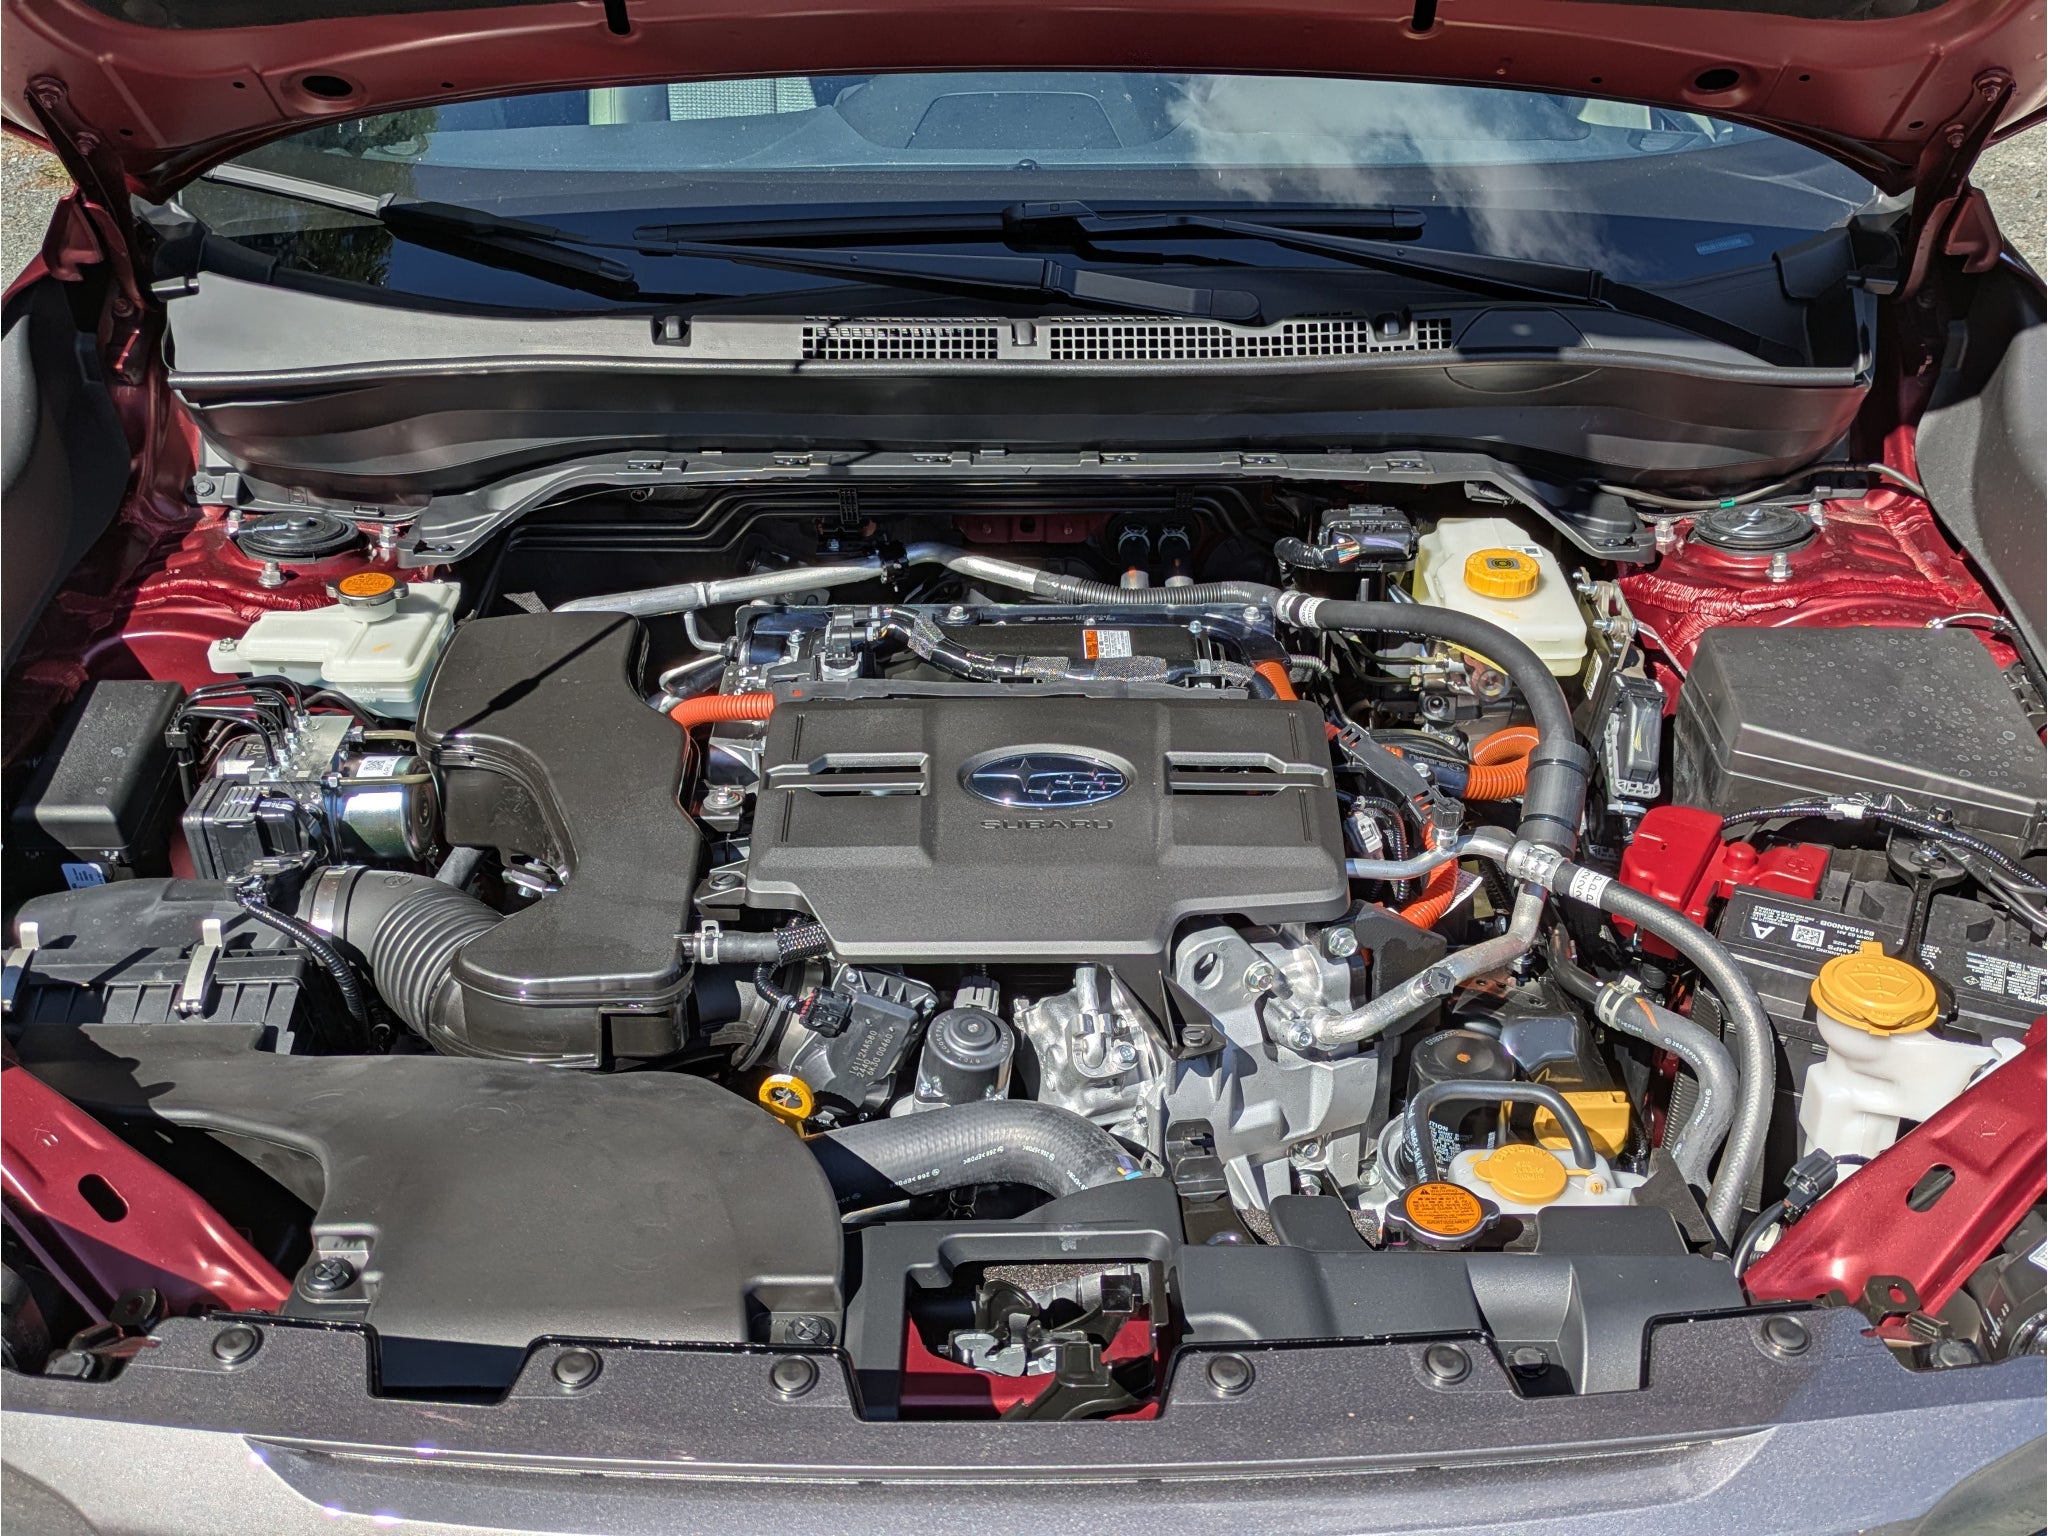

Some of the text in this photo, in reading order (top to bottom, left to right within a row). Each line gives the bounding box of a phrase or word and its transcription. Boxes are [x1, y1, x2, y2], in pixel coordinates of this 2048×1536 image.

[980, 819, 1114, 829] SUBARU
[1576, 880, 1598, 892] 2 P
[1751, 922, 1776, 940] A
[1827, 944, 1853, 955] AMPS
[857, 1059, 871, 1078] 2440
